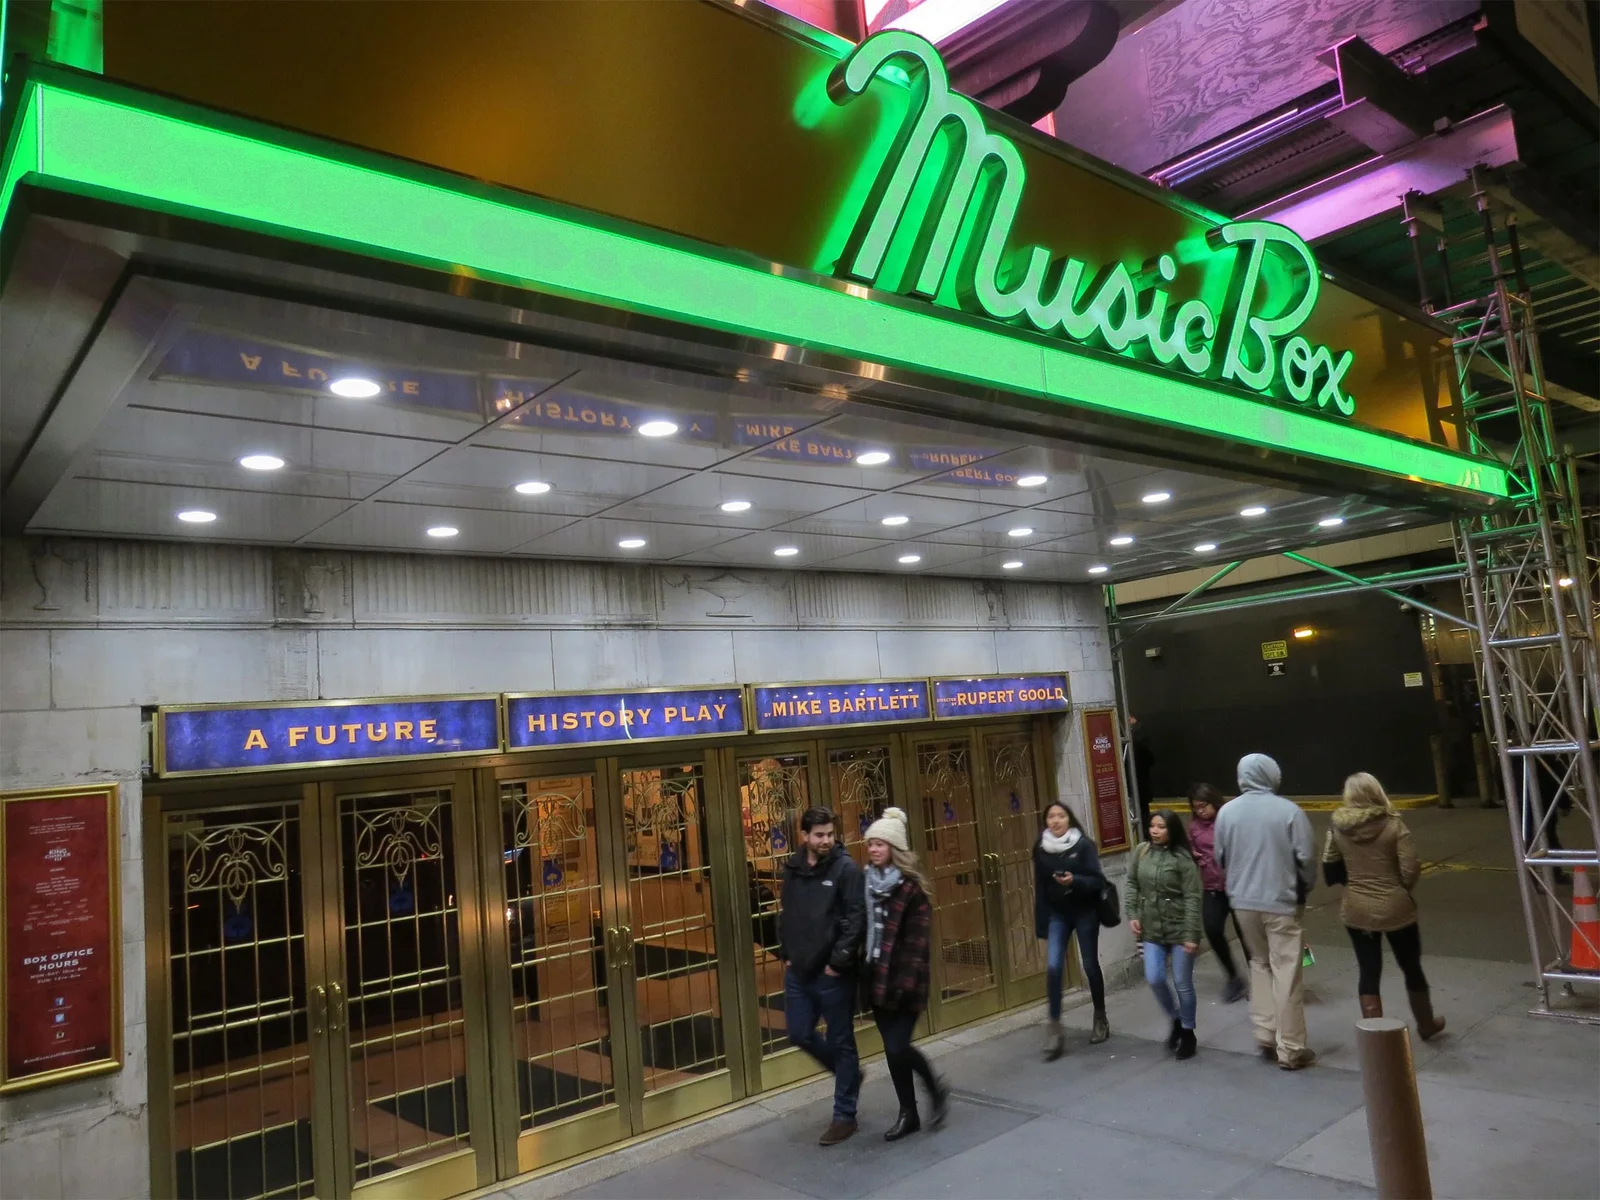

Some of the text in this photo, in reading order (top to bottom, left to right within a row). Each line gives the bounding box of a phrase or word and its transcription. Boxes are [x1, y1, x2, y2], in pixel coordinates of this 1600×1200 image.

[828, 29, 1356, 417] Music Box
[772, 699, 822, 717] MIKE
[829, 694, 920, 713] BARTLETT
[957, 690, 1014, 706] RUPERT
[1018, 687, 1063, 702] GOOLD
[528, 703, 728, 733] HISTORY PLAY
[244, 719, 438, 751] A FUTURE
[24, 947, 94, 965] BOX OFFICE
[38, 959, 79, 971] HOURS
